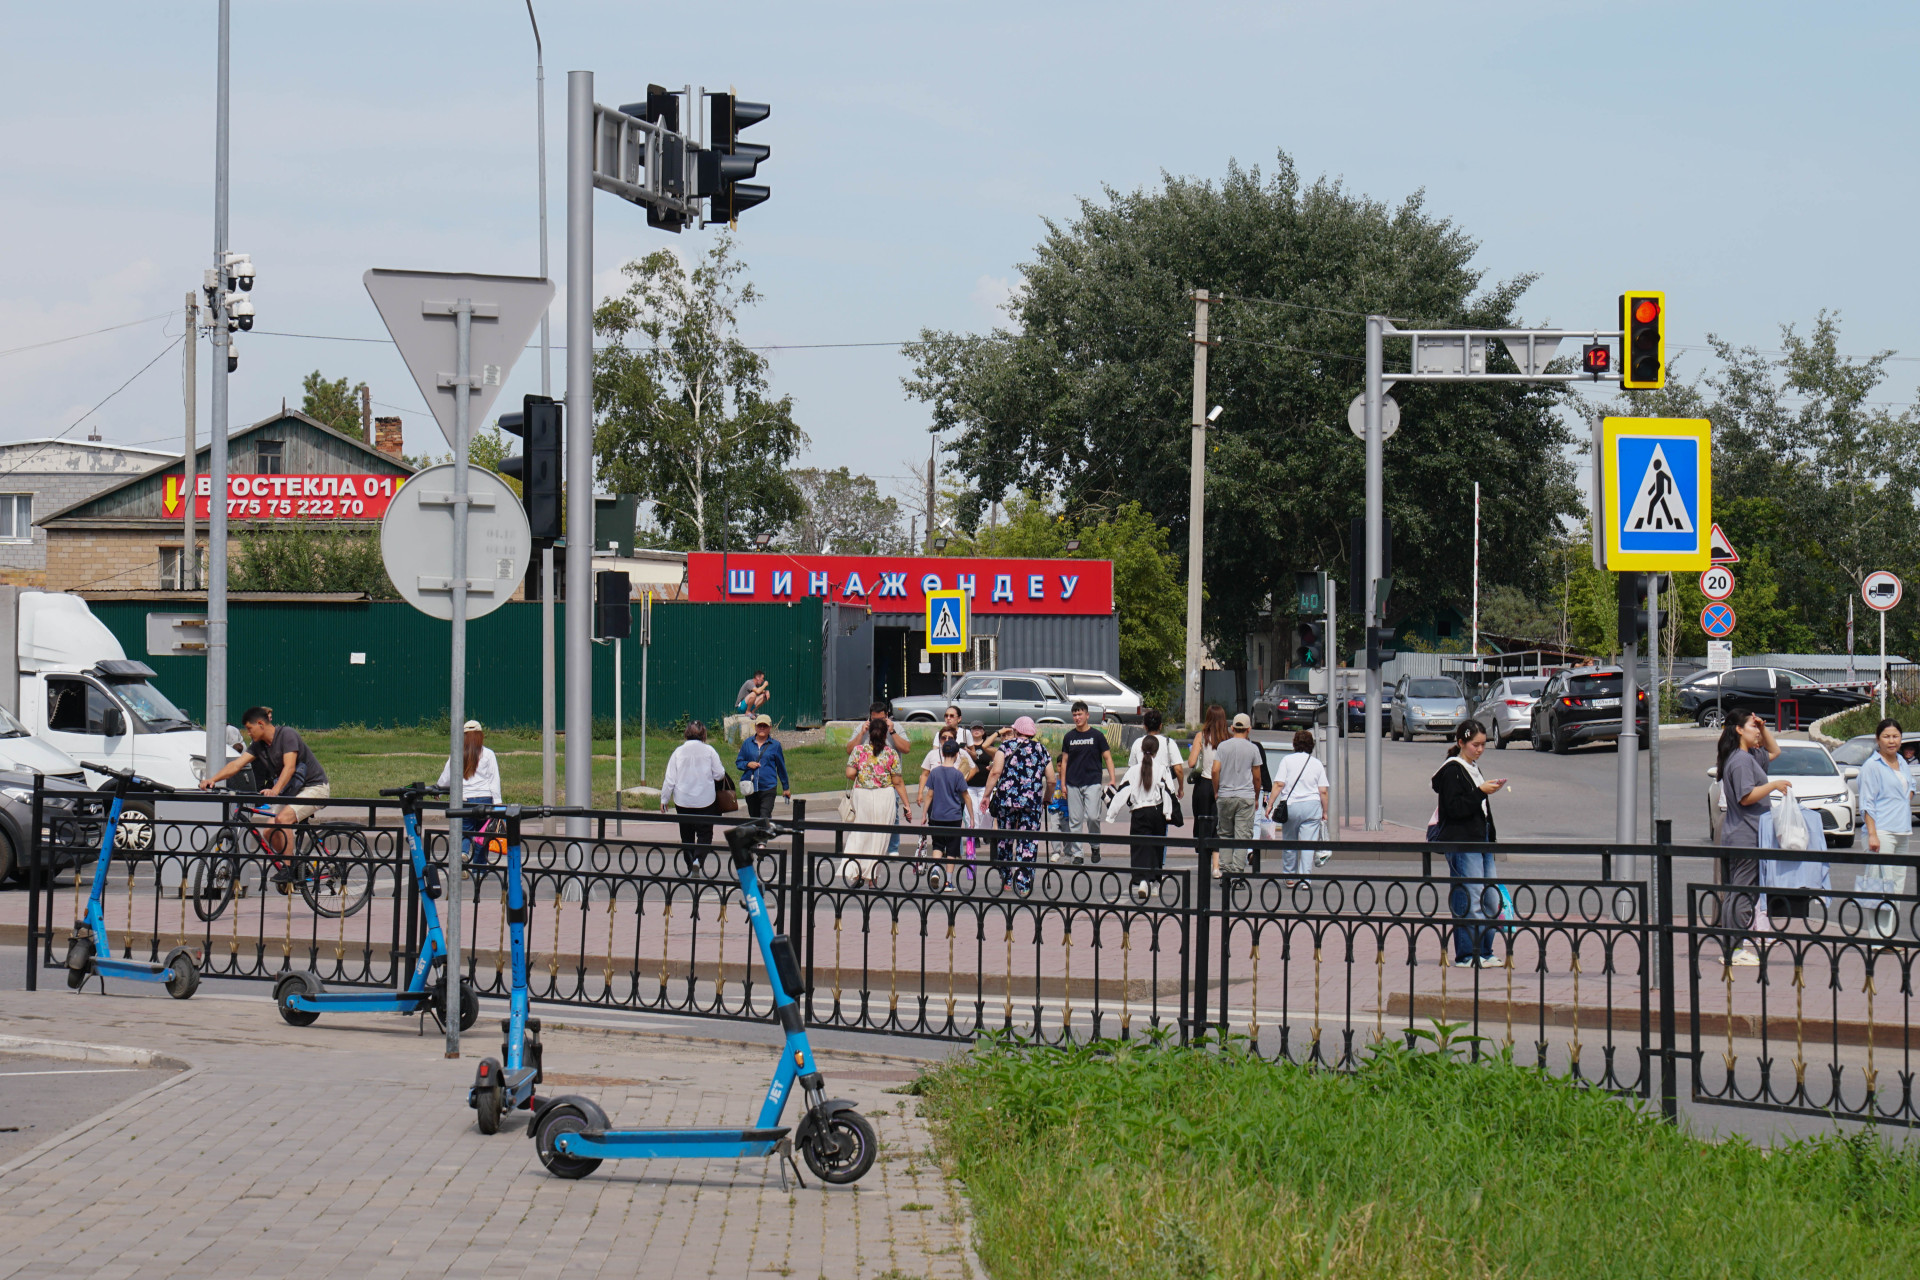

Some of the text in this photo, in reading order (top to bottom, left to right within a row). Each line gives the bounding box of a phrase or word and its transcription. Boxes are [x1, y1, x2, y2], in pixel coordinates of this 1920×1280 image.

[1588, 350, 1607, 366] 12
[178, 477, 391, 497] ВОСТЕКЛА 01
[227, 499, 260, 515] 775
[267, 499, 292, 515] 75
[297, 499, 334, 515] 222
[340, 499, 364, 515] 70
[1708, 576, 1727, 590] 20
[1301, 593, 1319, 609] 40
[746, 894, 761, 918] JET
[415, 957, 427, 975] JET
[768, 1079, 784, 1105] JET
